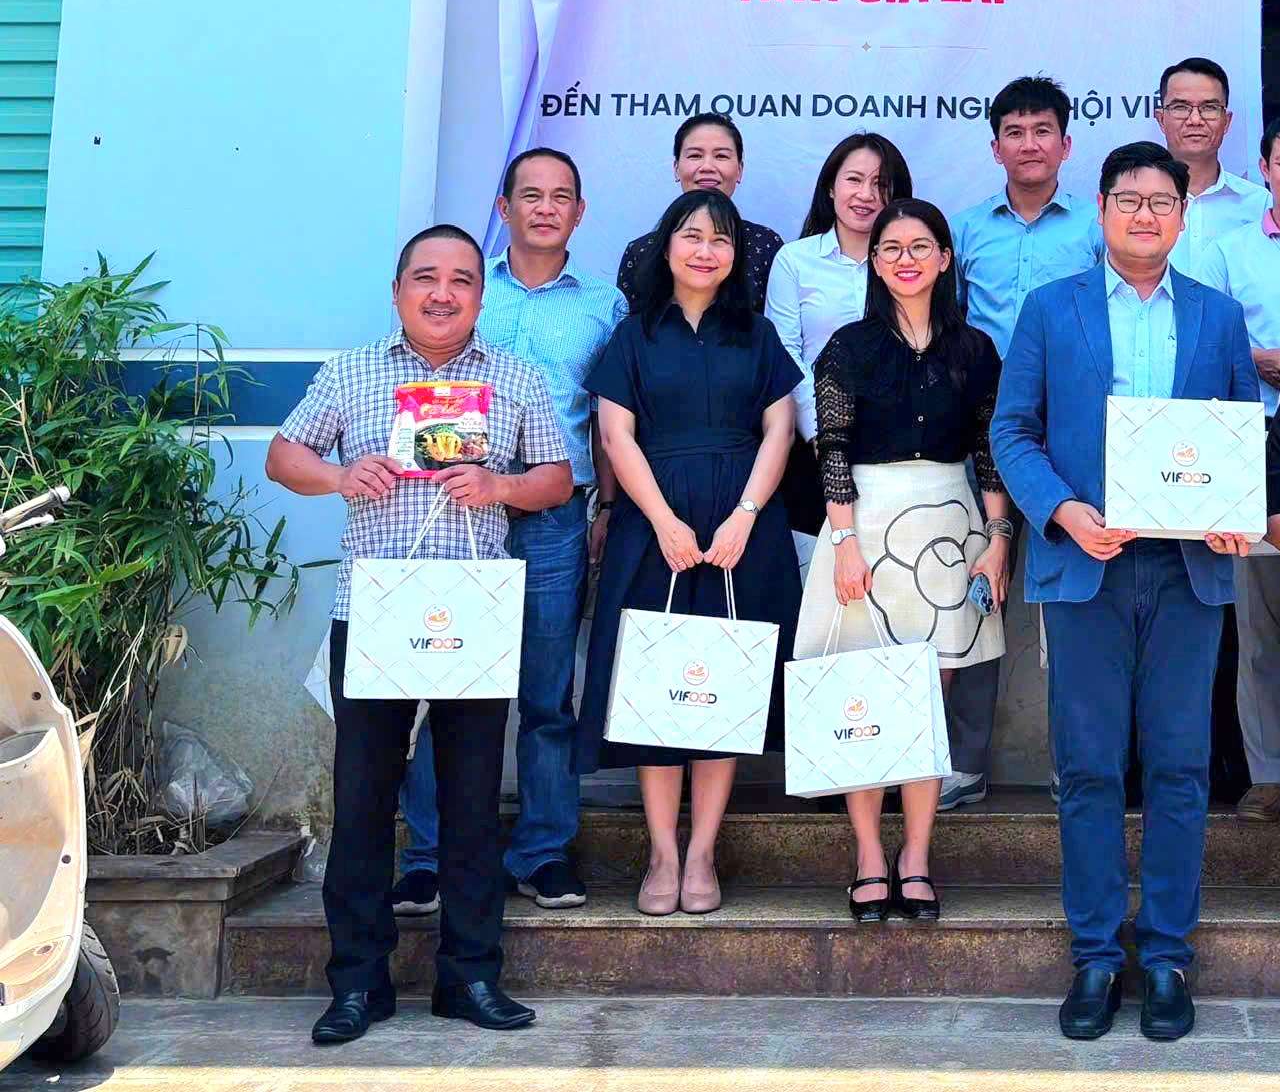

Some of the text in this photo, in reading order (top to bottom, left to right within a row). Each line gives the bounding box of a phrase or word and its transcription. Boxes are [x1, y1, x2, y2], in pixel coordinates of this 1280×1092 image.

[541, 81, 601, 117] ĐẾN
[611, 93, 701, 117] THAM
[711, 93, 802, 121] QUAN
[812, 93, 926, 118] DOANH
[1161, 471, 1212, 484] VIFOOD
[409, 637, 463, 650] VIFOOD
[669, 689, 717, 705] VIFOOD
[834, 724, 881, 741] VIFOOD
